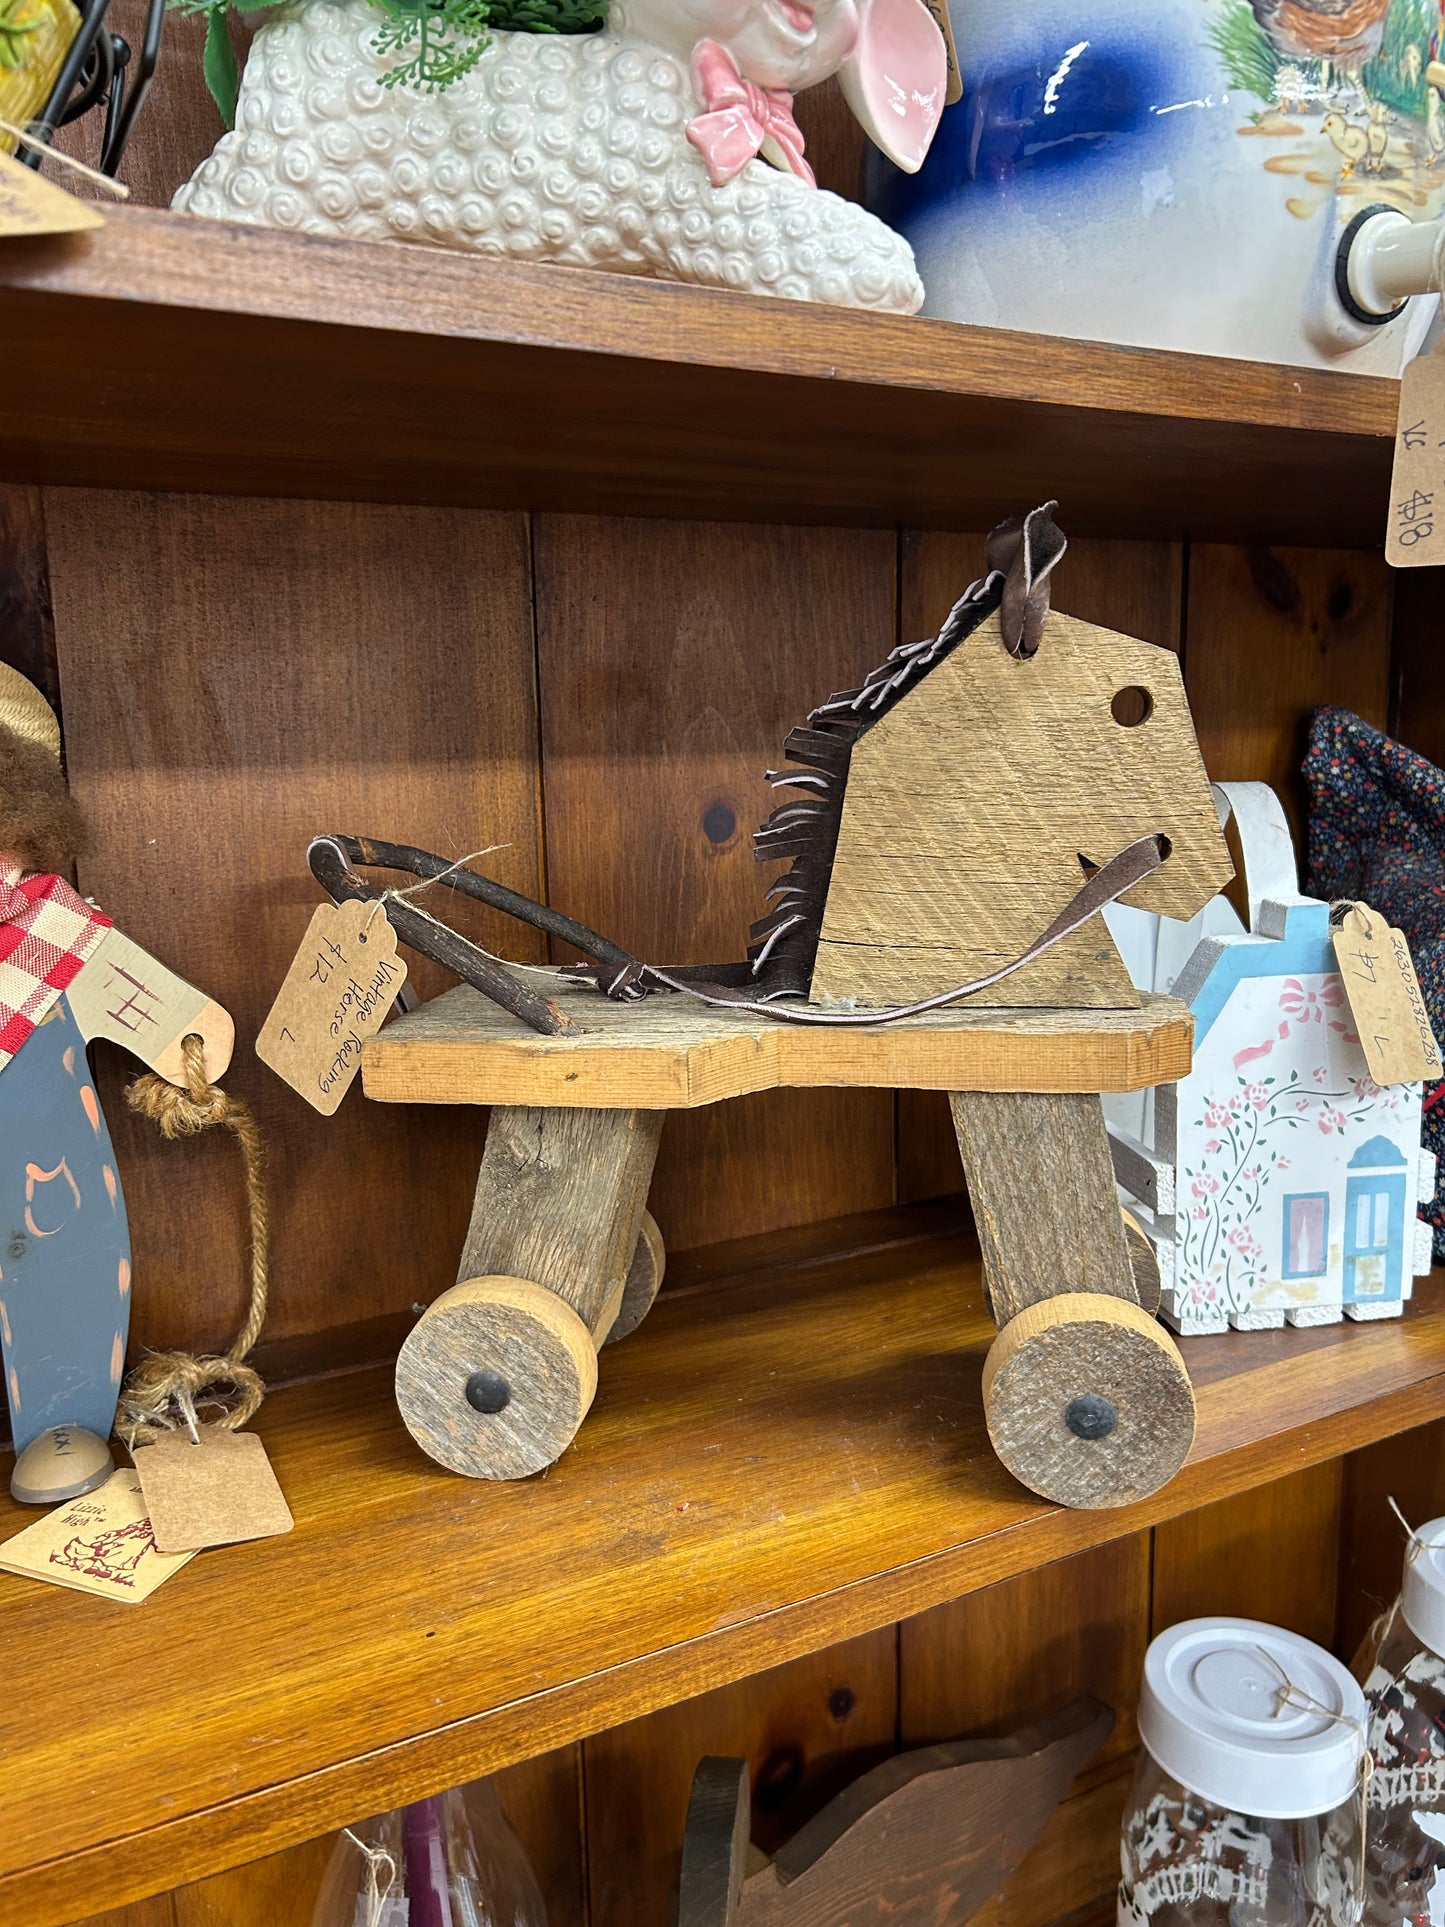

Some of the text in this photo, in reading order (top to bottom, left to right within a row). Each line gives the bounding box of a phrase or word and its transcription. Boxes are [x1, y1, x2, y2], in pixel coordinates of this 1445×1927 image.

[1397, 489, 1434, 546] $18
[310, 936, 348, 983] $12
[1348, 948, 1379, 984] $7
[318, 961, 398, 1094] Vintage Rocking
[329, 978, 364, 1038] Horse
[70, 1502, 107, 1515] Lizzie
